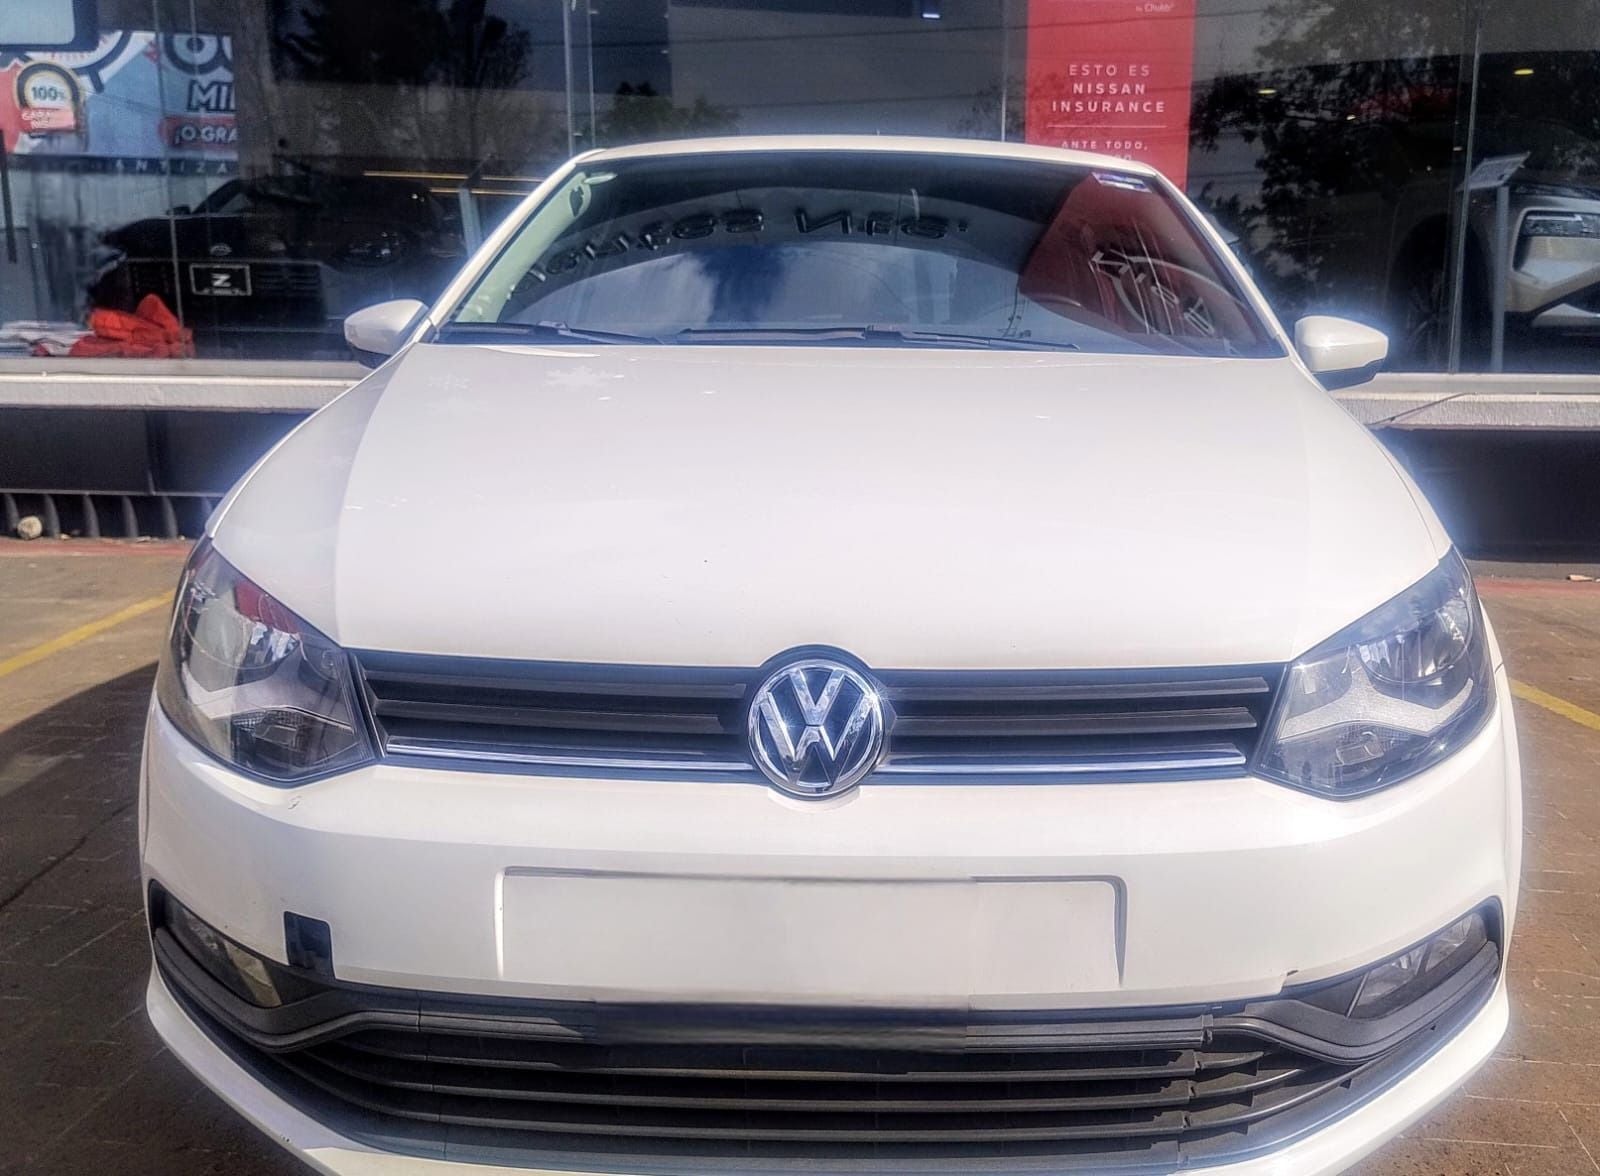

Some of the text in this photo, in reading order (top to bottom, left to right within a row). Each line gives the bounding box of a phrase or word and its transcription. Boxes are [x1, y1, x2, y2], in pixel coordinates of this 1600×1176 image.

[1069, 64, 1150, 77] ESTO ES
[1073, 83, 1145, 95] NISSAN
[1052, 101, 1166, 113] INSURANCE
[1061, 140, 1097, 149] ANTE
[756, 668, 876, 787] VW
